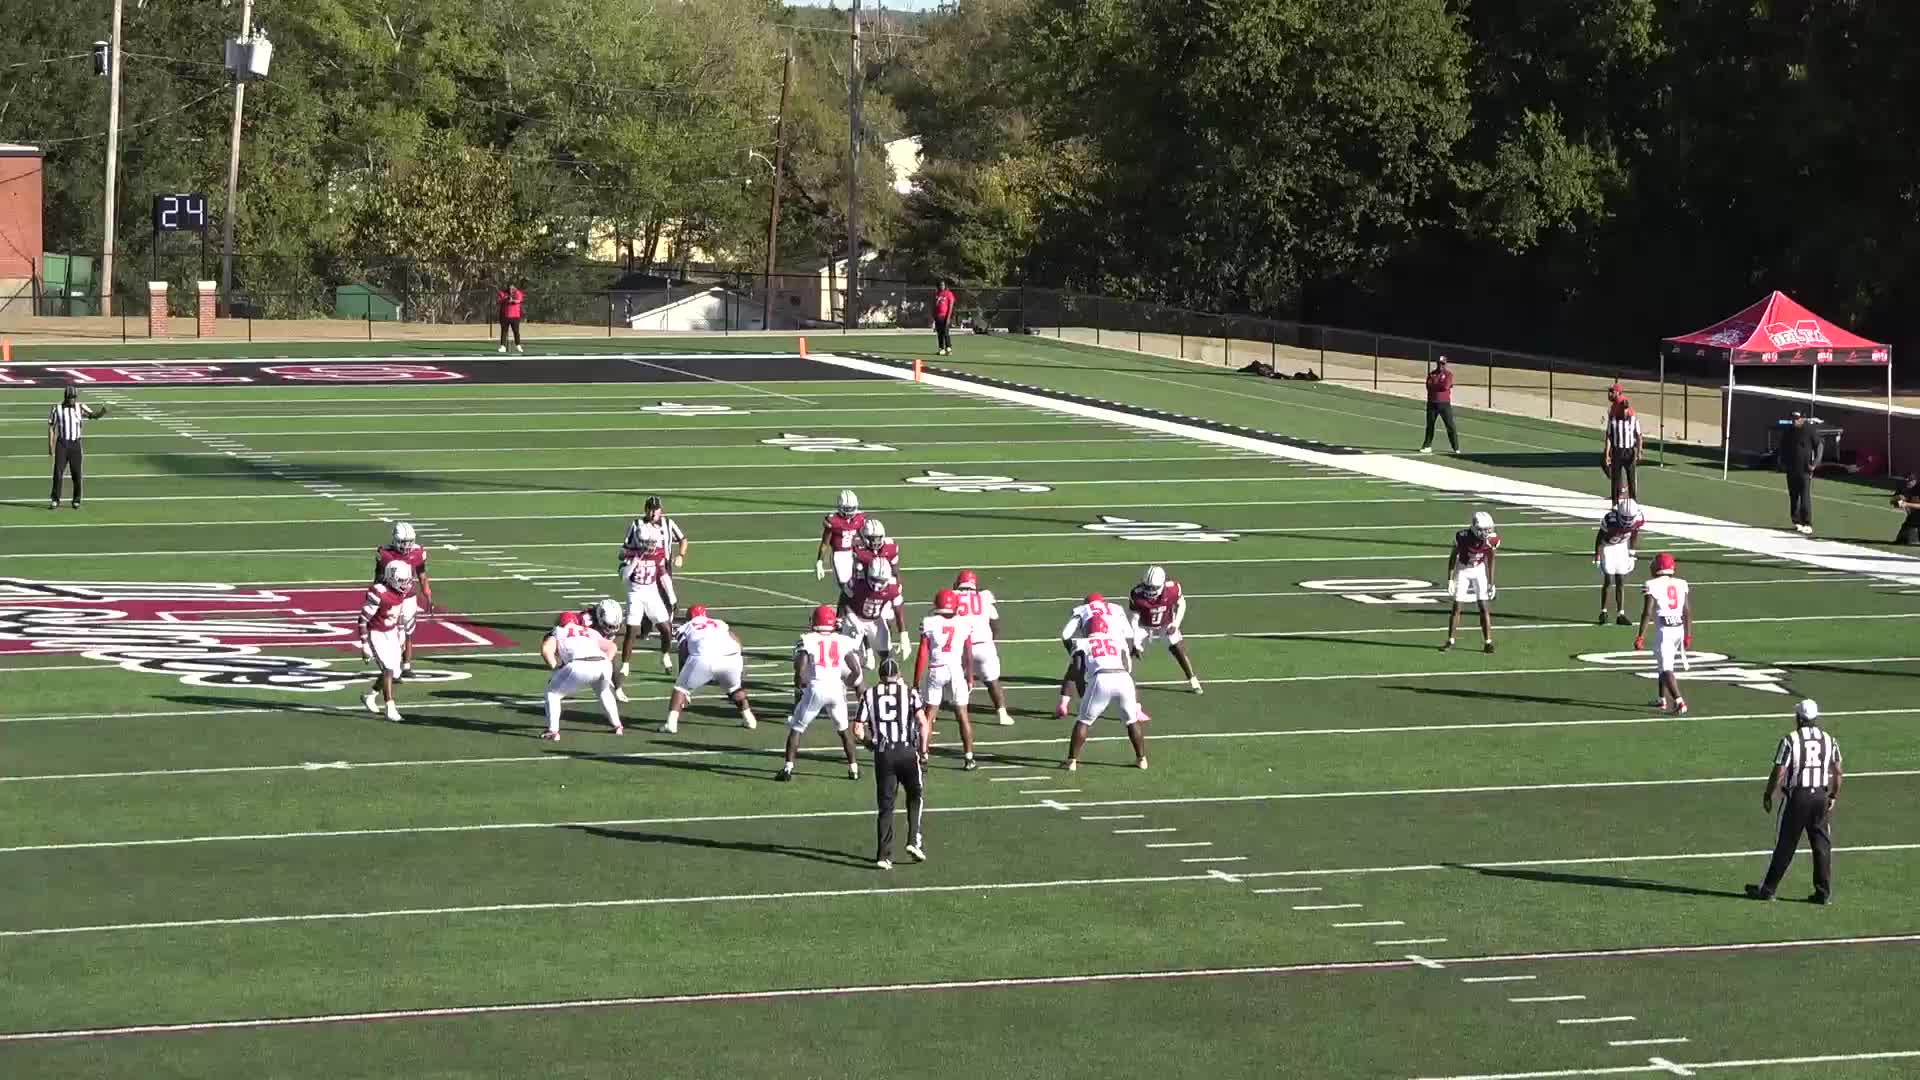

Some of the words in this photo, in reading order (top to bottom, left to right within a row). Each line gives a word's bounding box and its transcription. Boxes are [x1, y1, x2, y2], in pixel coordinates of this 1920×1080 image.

[162, 197, 203, 227] 24
[0, 364, 467, 384] ES
[761, 437, 899, 453] 20
[905, 475, 1054, 494] 30
[1081, 522, 1241, 543] 40
[956, 593, 983, 616] 50
[1666, 585, 1679, 609] 9
[941, 626, 956, 652] 7
[1089, 639, 1119, 658] 26
[817, 640, 841, 668] 14
[879, 695, 897, 720] C
[1804, 741, 1821, 767] R
